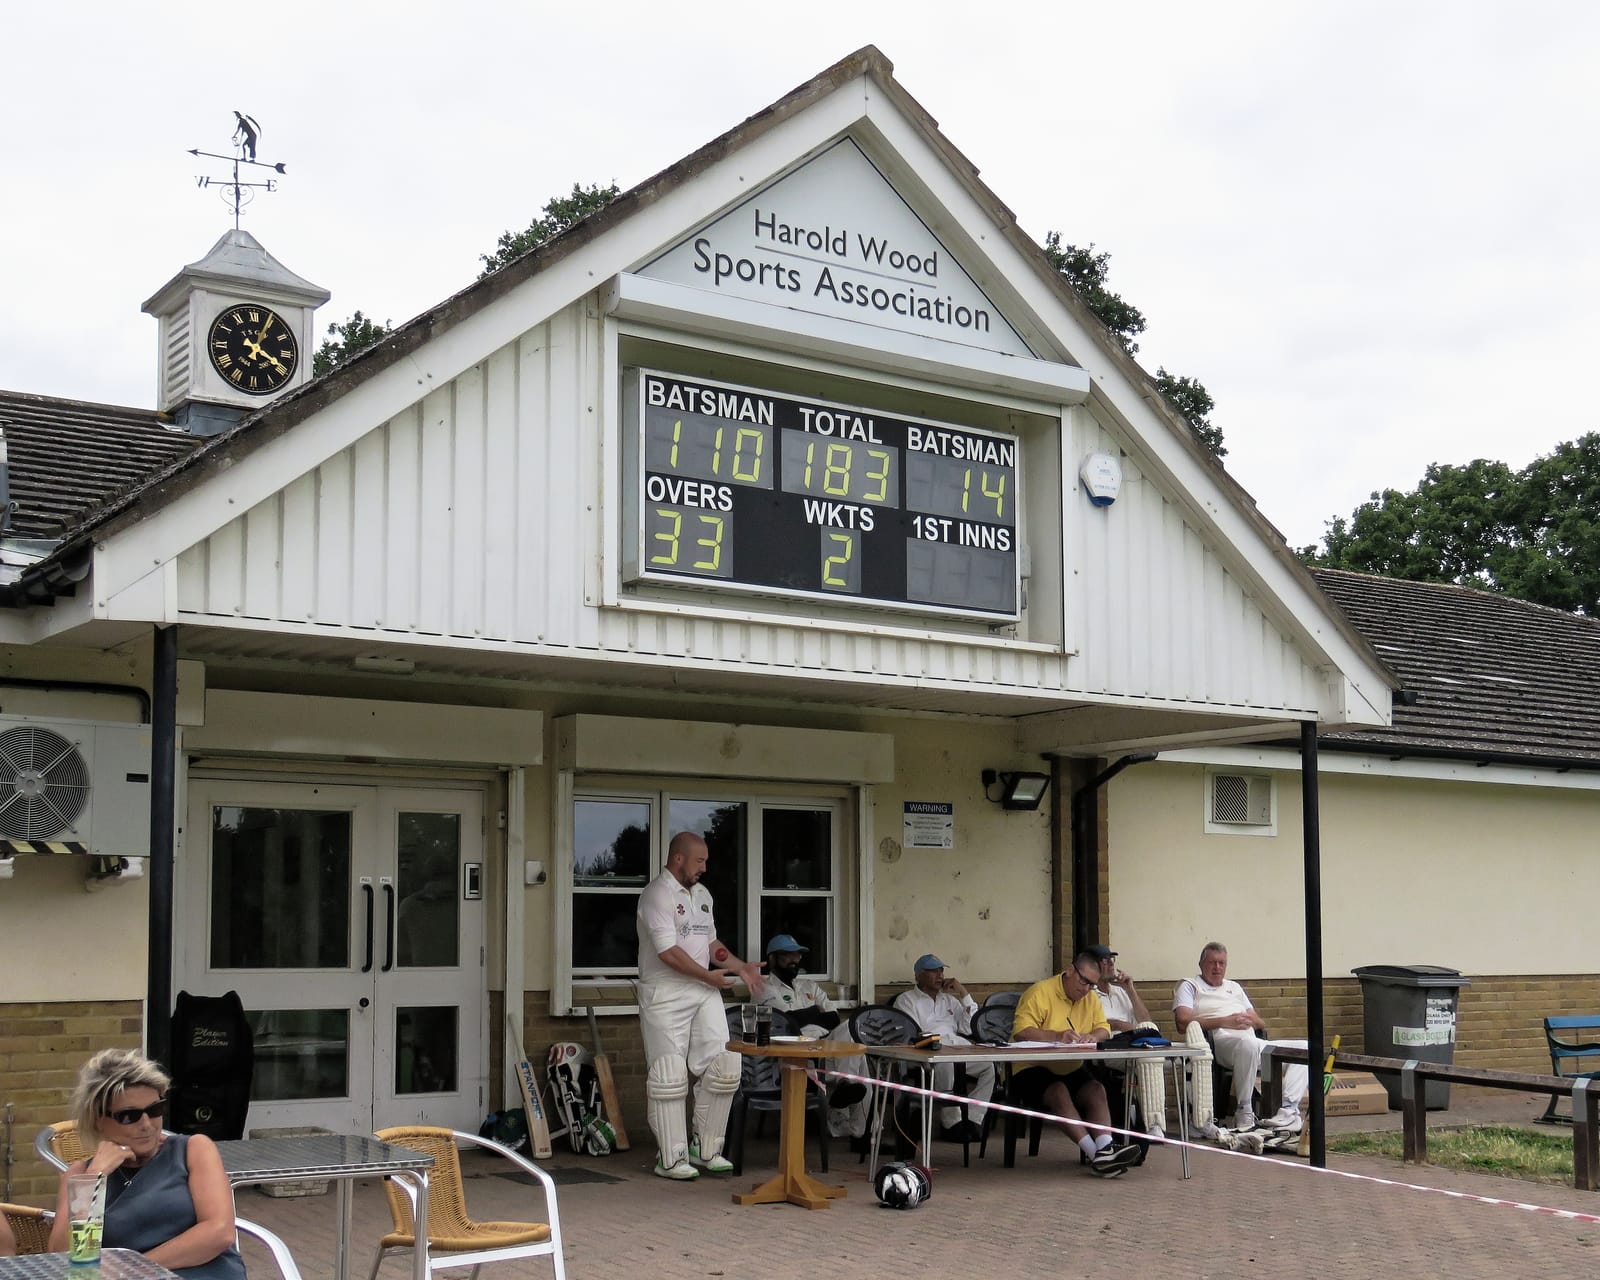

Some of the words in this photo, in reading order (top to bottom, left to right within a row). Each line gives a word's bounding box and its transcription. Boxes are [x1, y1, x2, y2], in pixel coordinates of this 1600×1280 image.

[754, 208, 847, 257] Harold
[858, 233, 938, 278] Wood
[693, 238, 802, 292] Sports
[814, 266, 990, 333] Association
[647, 379, 775, 426] BATSMAN
[799, 407, 883, 445] TOTAL
[907, 426, 1014, 468] BATSMAN
[803, 441, 890, 501] 183
[646, 475, 734, 512] OVERS
[962, 467, 1005, 519] 14
[803, 499, 875, 532] WKTS
[912, 515, 955, 544] 1ST
[959, 523, 1011, 552] INNS
[650, 508, 725, 571] 33
[823, 533, 853, 587] 2
[909, 803, 948, 814] WARNING
[191, 1036, 229, 1048] Edition
[1401, 1031, 1425, 1041] GLASS
